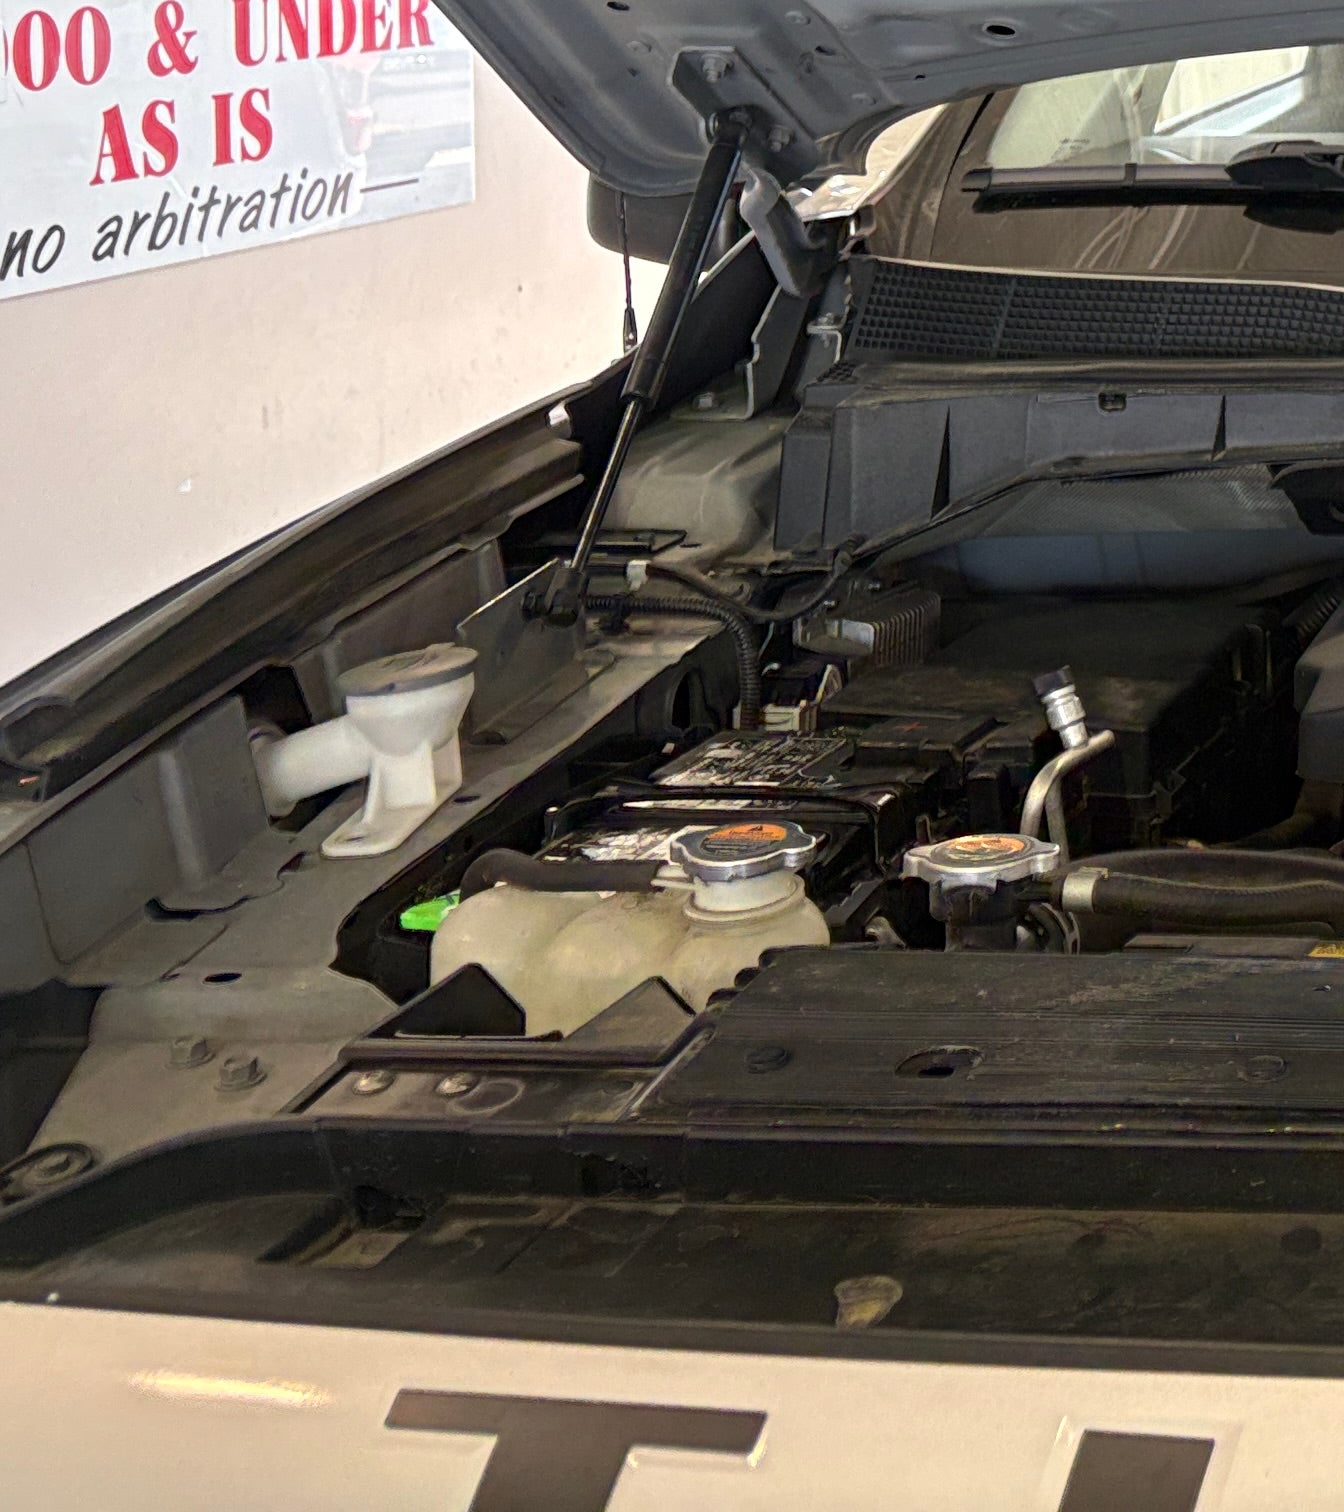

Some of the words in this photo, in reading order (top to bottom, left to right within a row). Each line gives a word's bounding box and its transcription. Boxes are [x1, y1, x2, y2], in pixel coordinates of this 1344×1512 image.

[0, 6, 112, 92] 00
[146, 0, 199, 77] &
[89, 99, 180, 187] AS
[211, 87, 274, 167] IS
[0, 223, 66, 282] no
[91, 167, 354, 263] arbitration
